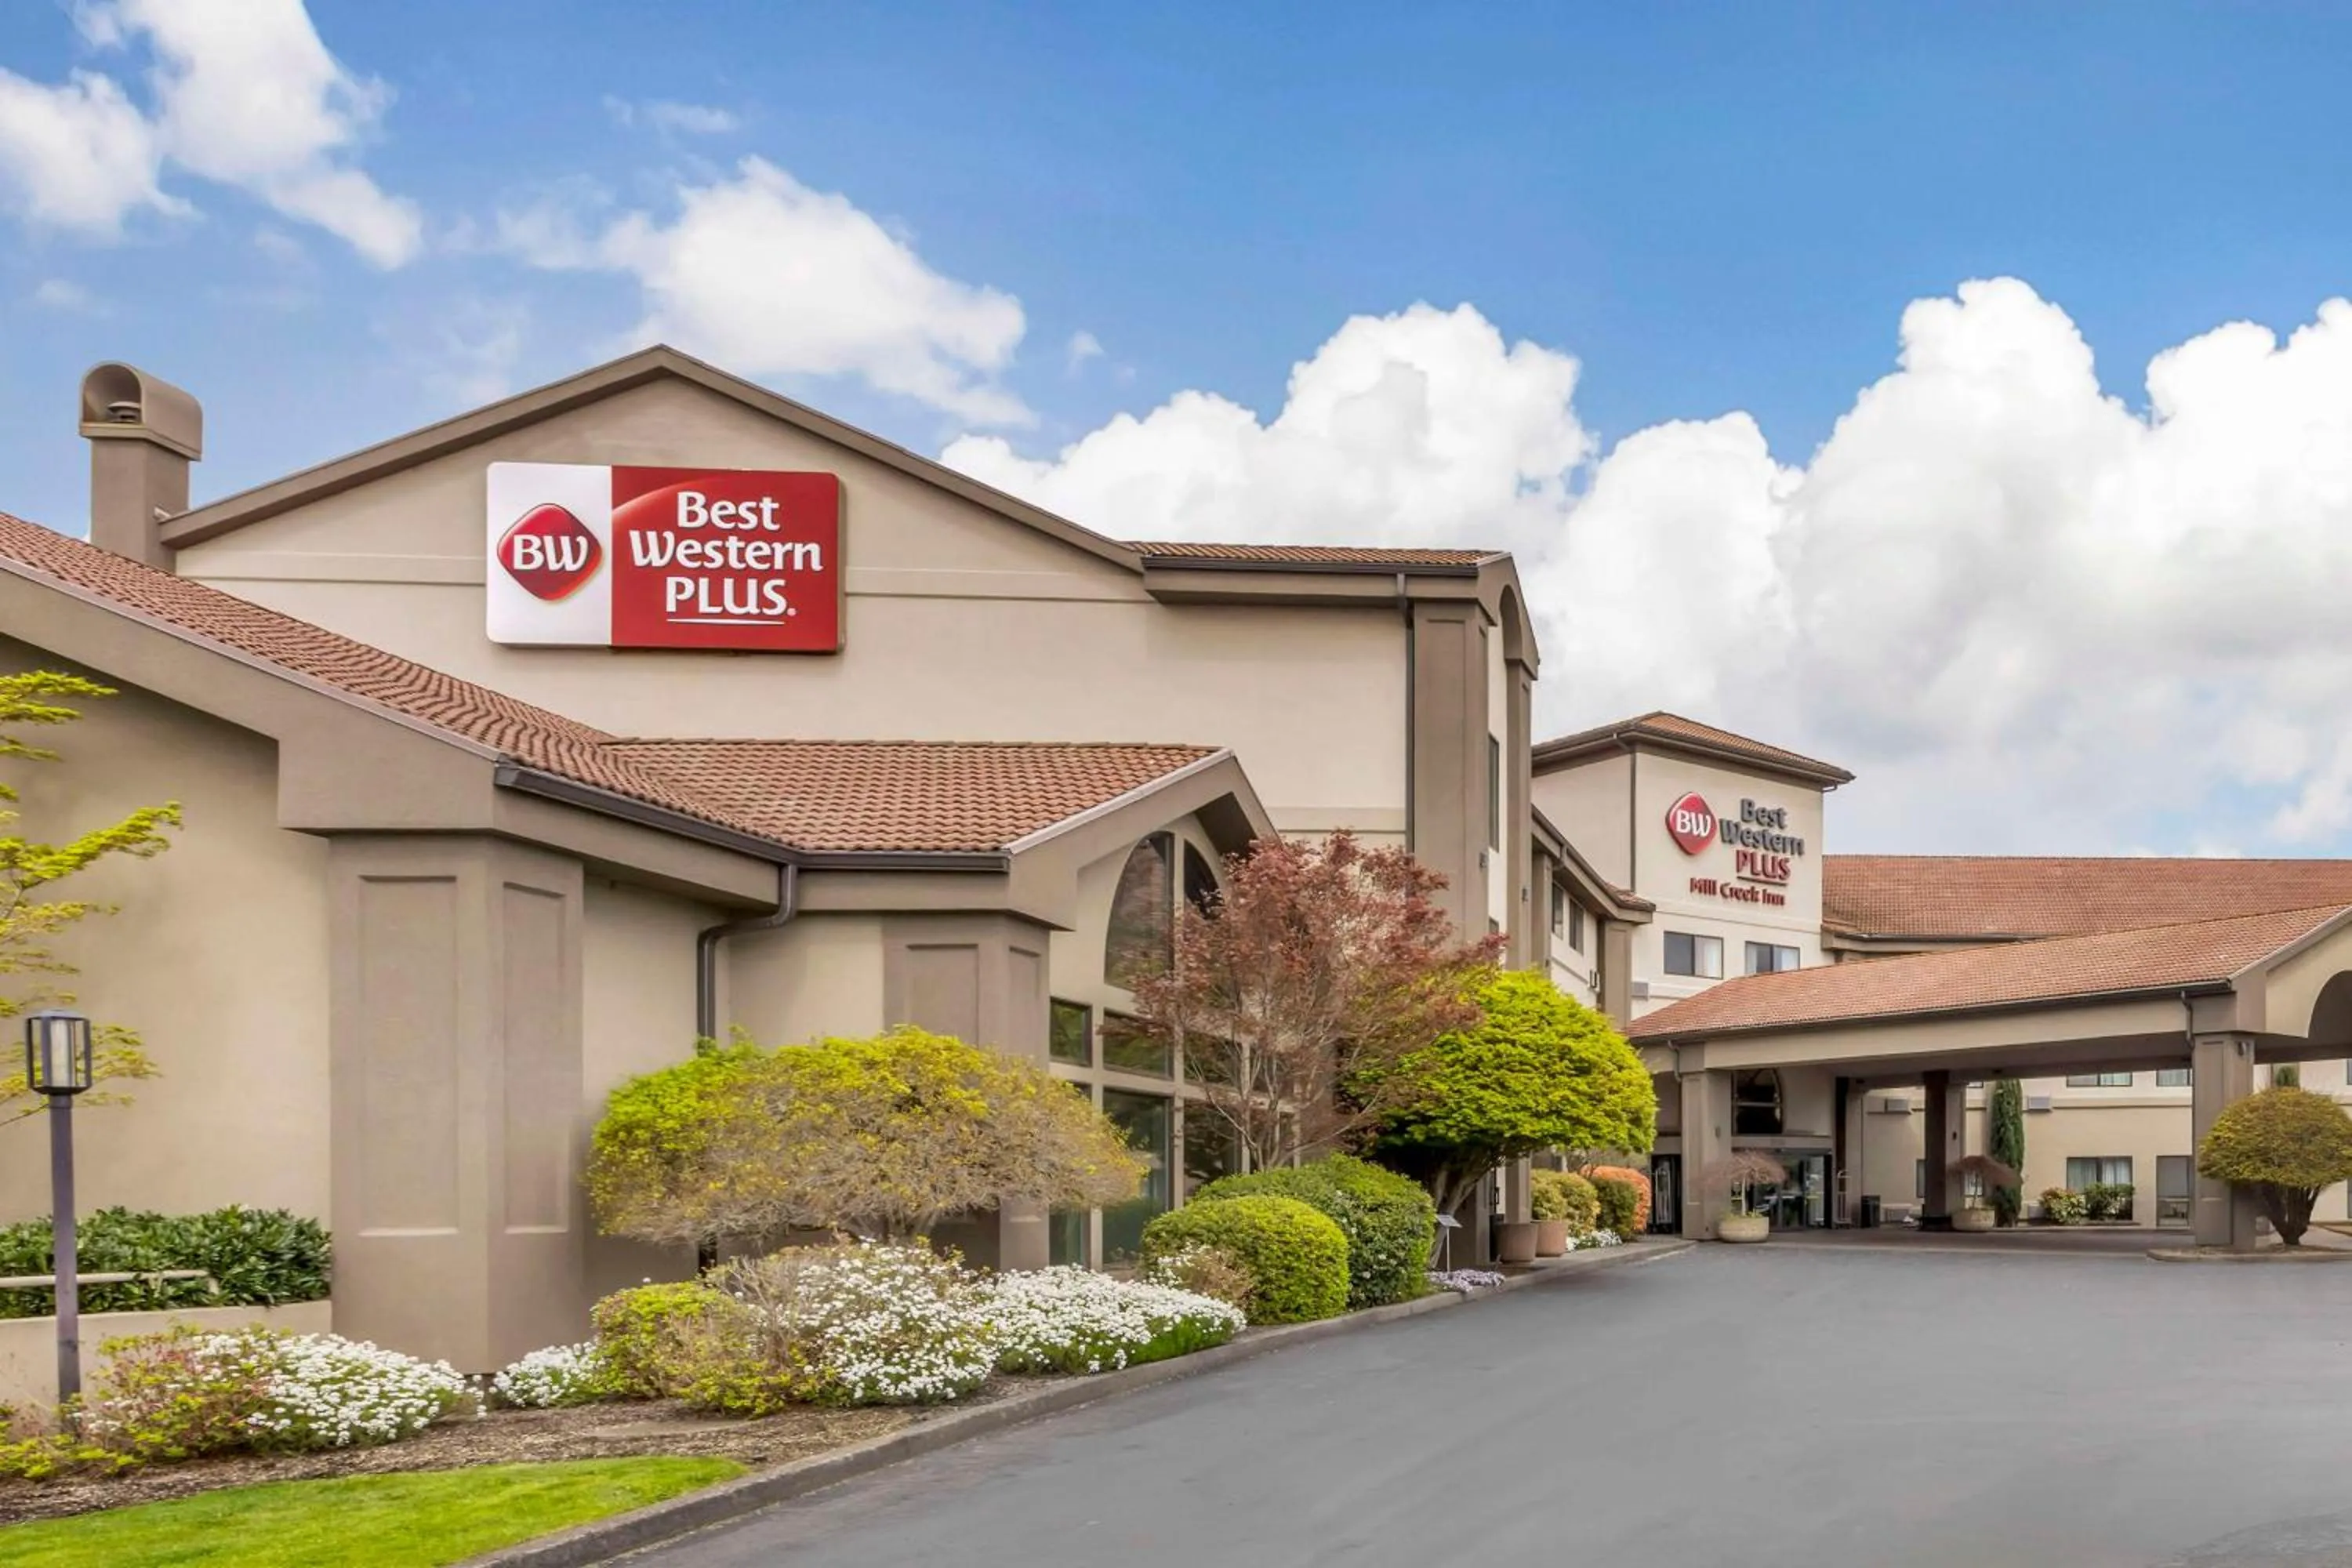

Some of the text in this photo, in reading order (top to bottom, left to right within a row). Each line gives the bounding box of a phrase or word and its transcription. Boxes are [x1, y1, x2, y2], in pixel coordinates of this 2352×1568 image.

[677, 491, 780, 529] Best
[511, 534, 587, 572] BW
[630, 530, 823, 572] Western
[1676, 810, 1711, 837] BW
[1740, 798, 1787, 829] Best
[1719, 818, 1804, 855] Western
[1736, 849, 1790, 880] PLUS
[1690, 877, 1785, 906] Mill Creek Inn
